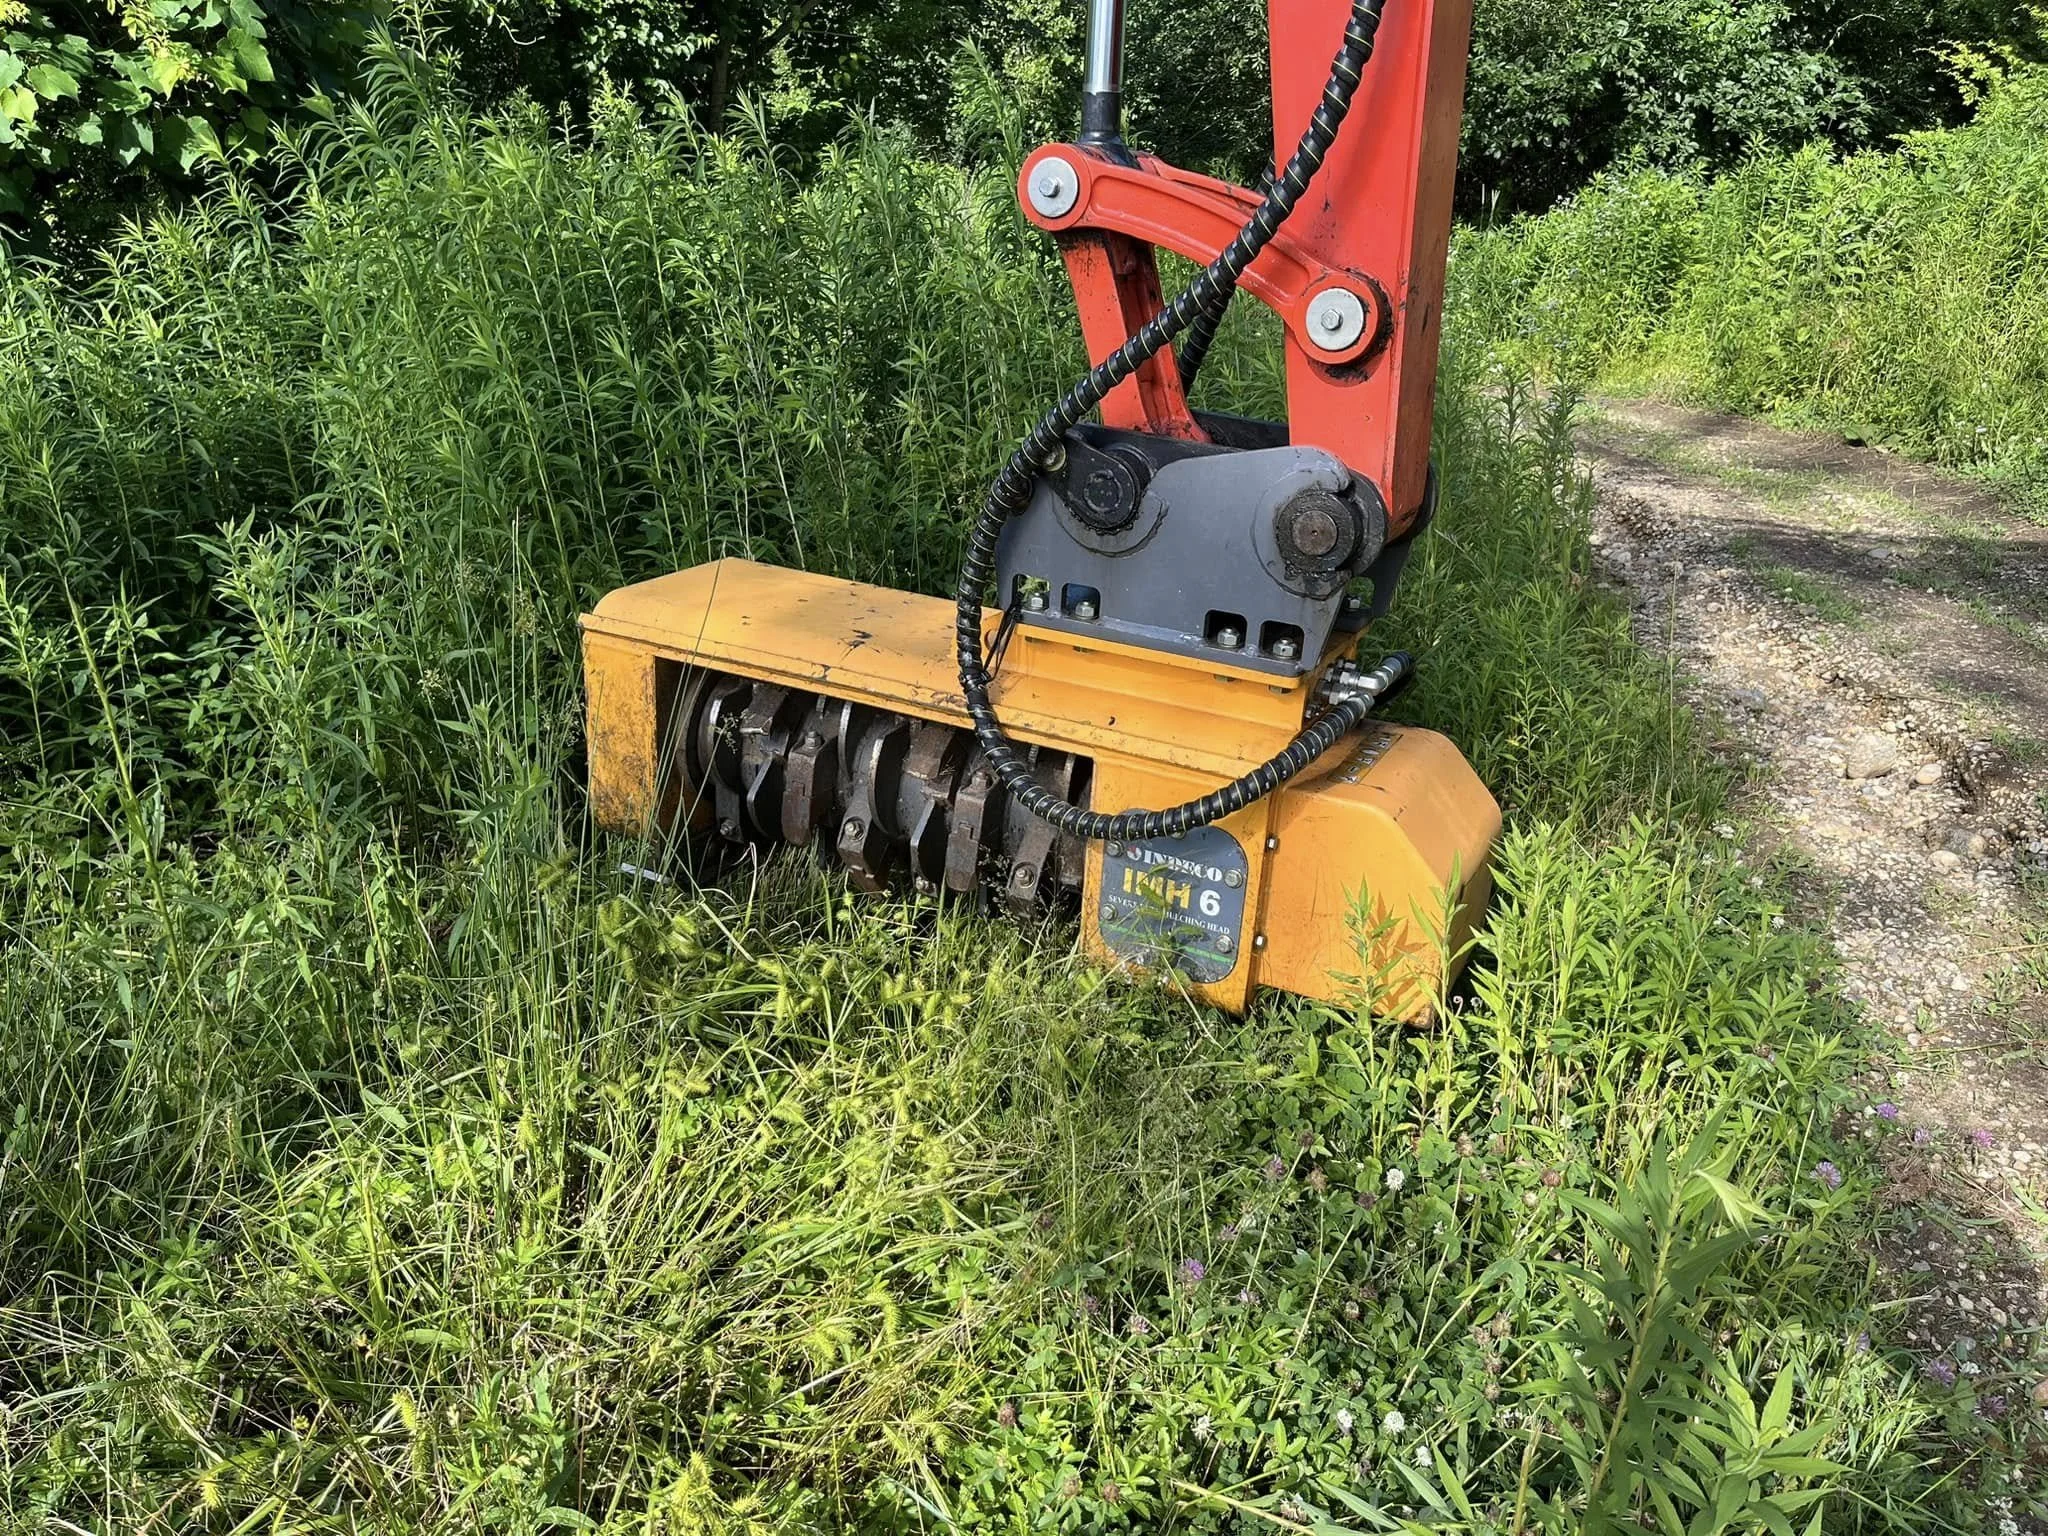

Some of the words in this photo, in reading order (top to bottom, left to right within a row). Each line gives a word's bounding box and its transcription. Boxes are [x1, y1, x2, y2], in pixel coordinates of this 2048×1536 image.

[1143, 849, 1223, 882] INDECO
[1199, 889, 1222, 917] 6
[1207, 922, 1231, 935] HEAD
